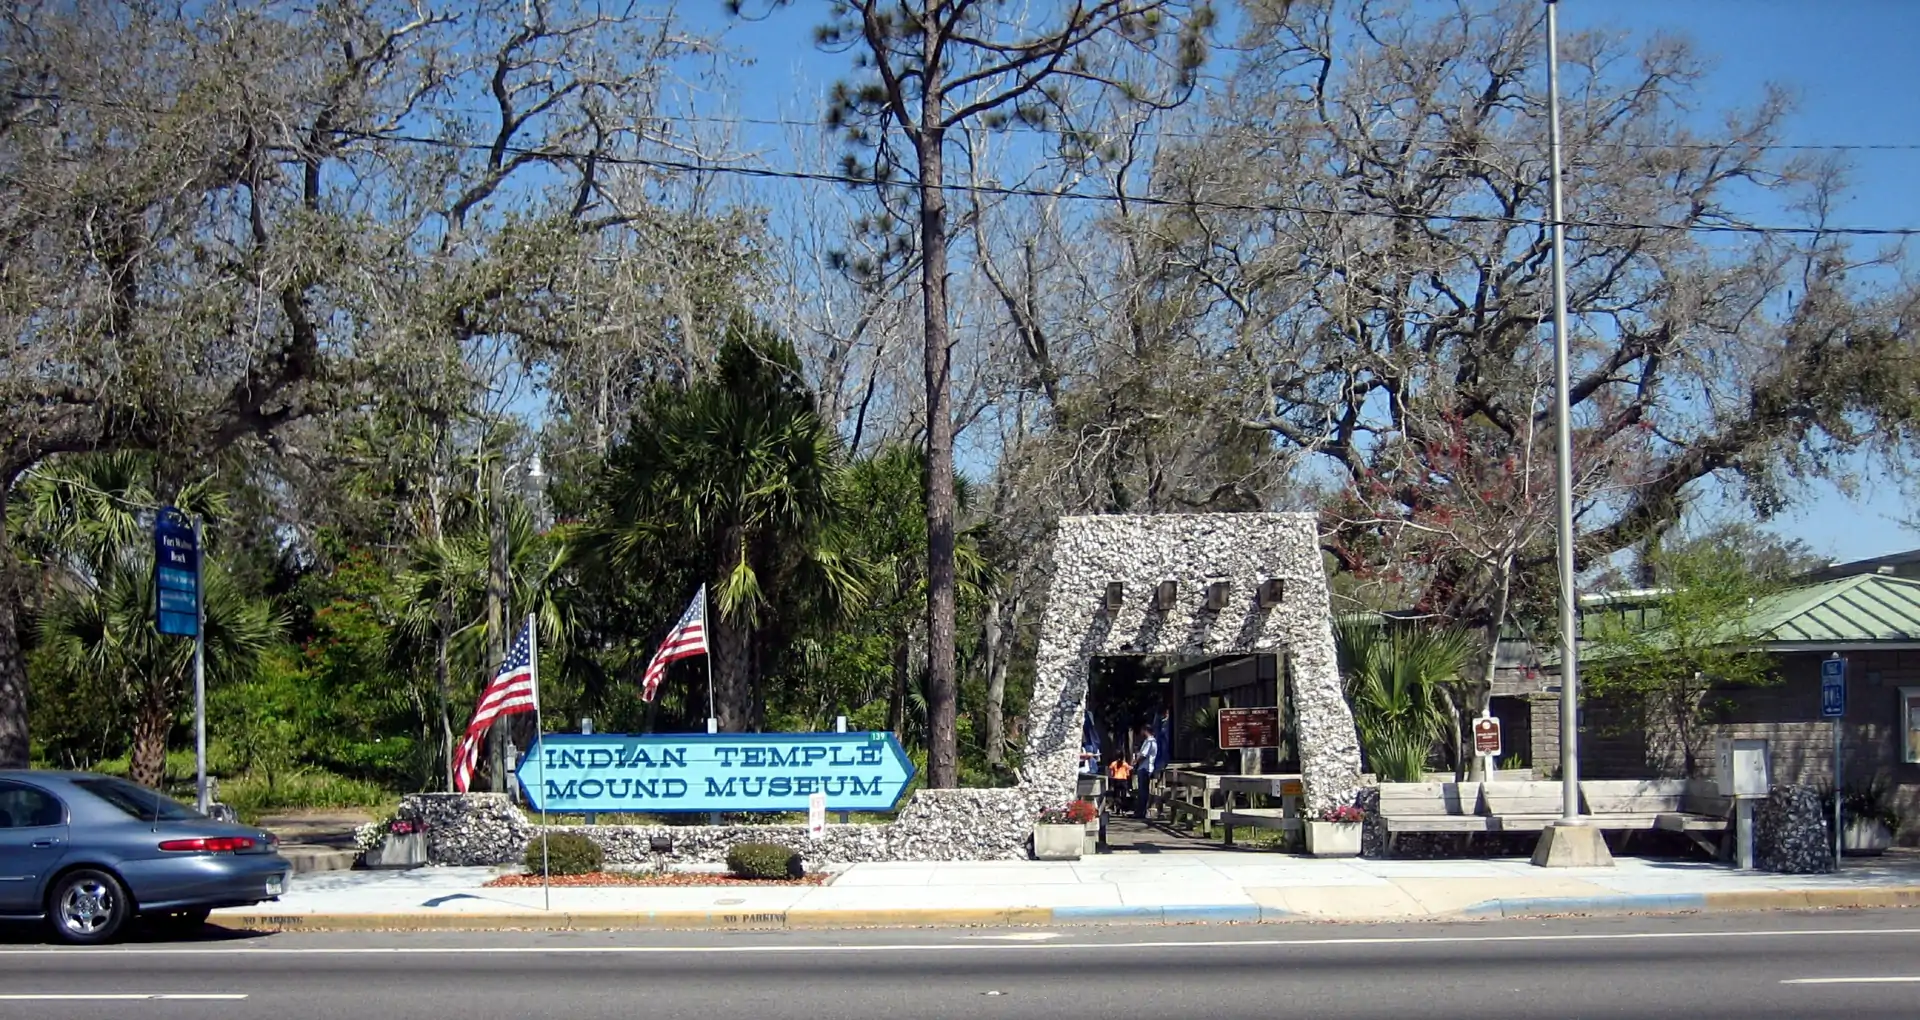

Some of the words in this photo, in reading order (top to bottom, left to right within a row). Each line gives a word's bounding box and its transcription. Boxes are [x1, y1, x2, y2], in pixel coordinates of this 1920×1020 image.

[171, 550, 186, 563] Beach
[872, 732, 885, 741] 139
[544, 747, 688, 770] INDIAN
[714, 746, 883, 768] TEMPLE
[544, 778, 688, 799] MOUND
[704, 776, 883, 798] MUSEUM
[243, 916, 256, 925] NO
[261, 916, 304, 925] PARKING
[723, 914, 737, 923] NO
[742, 912, 786, 923] PARKING
